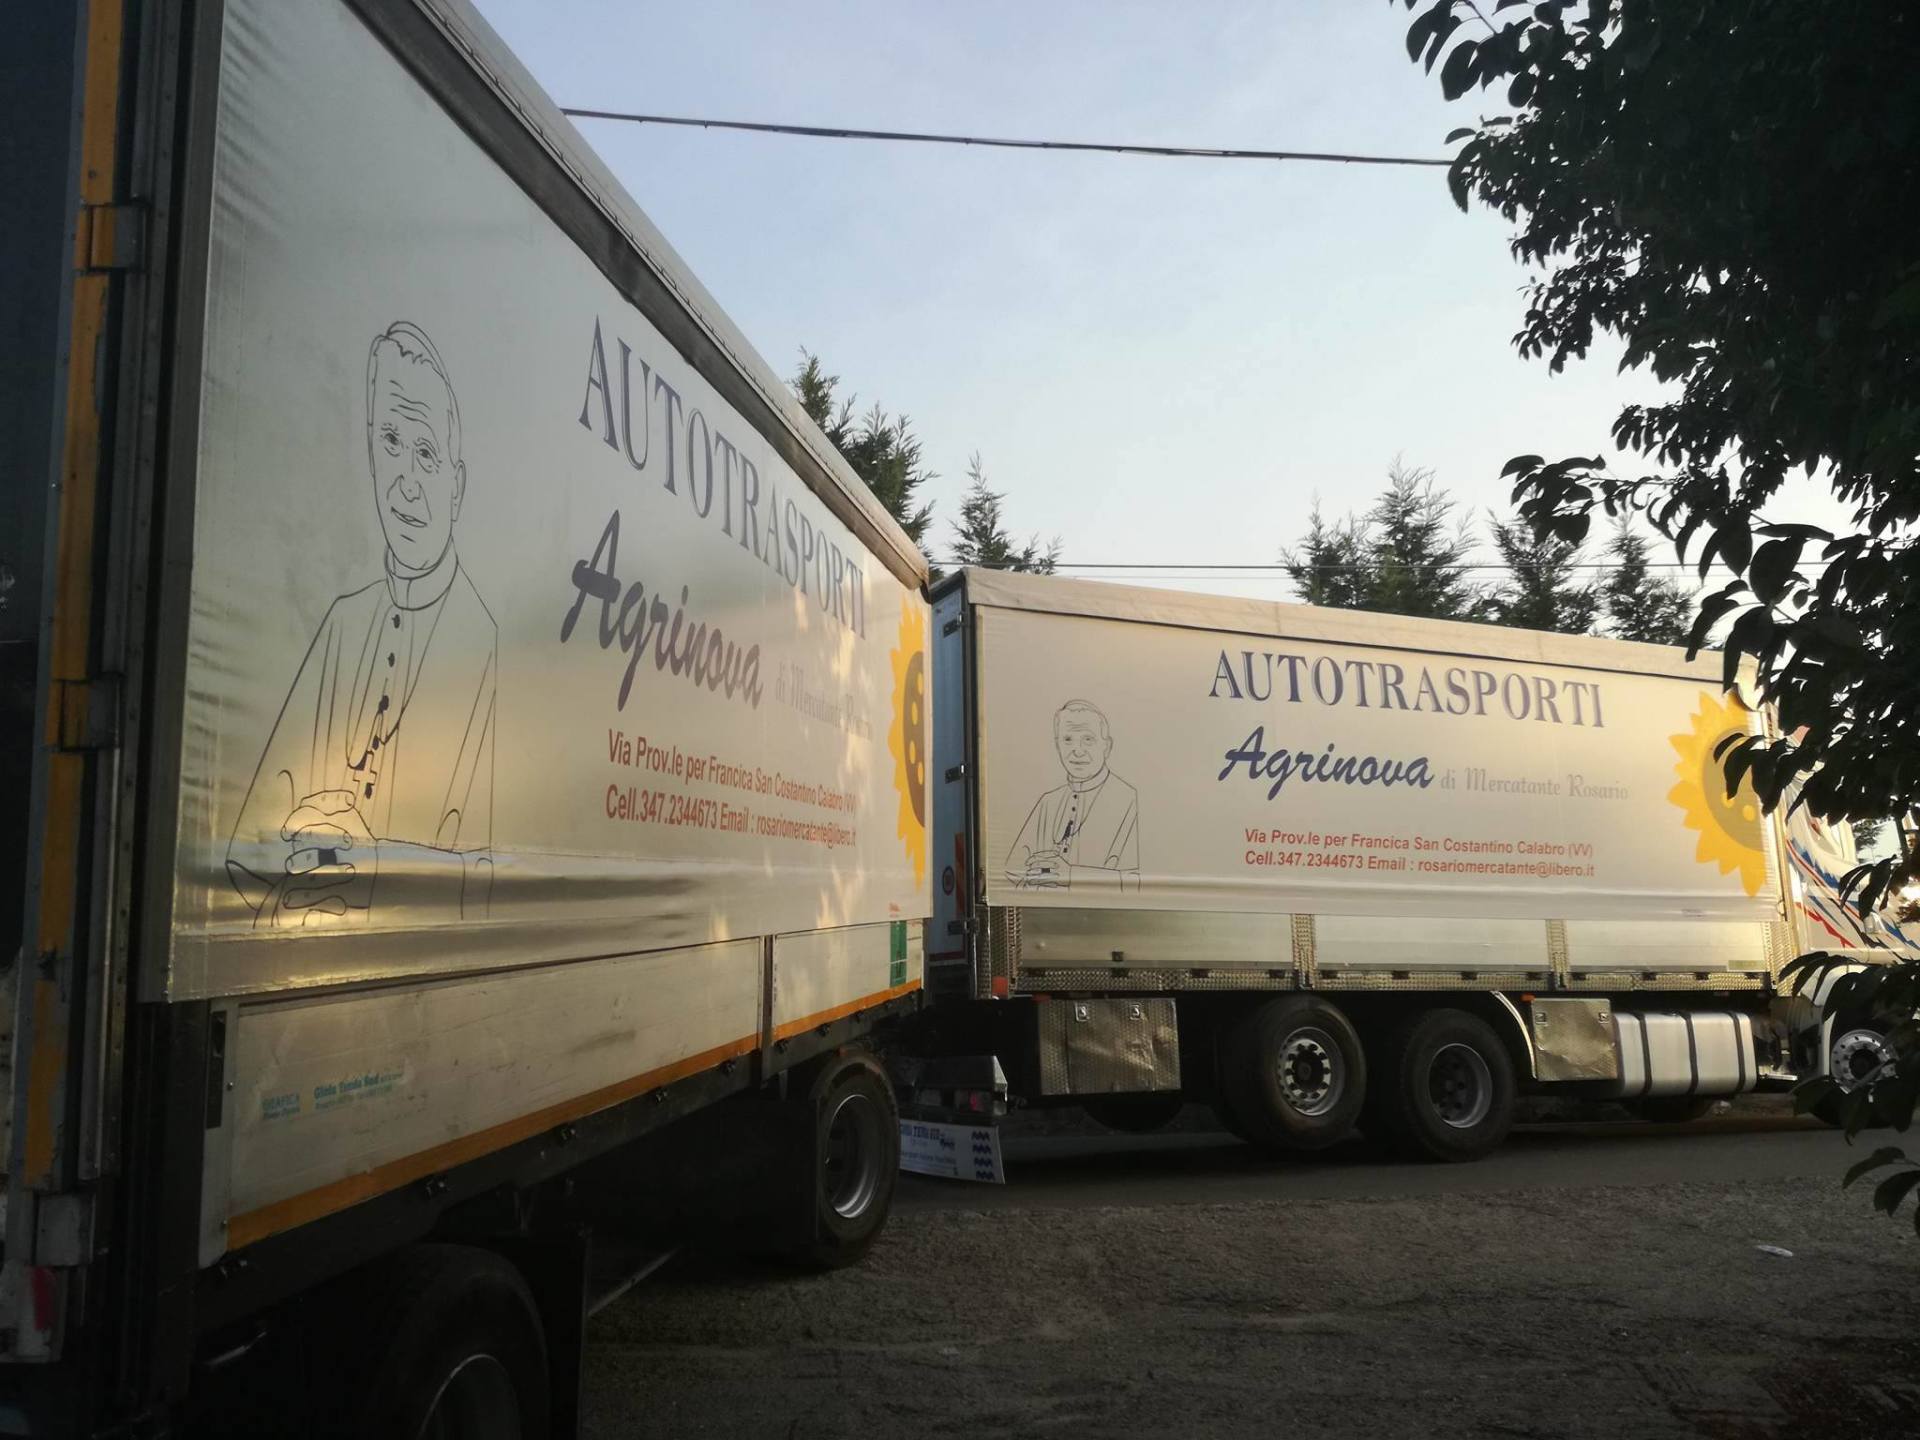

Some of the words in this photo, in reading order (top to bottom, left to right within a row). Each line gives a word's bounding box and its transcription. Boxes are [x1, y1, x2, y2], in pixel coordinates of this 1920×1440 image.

[578, 313, 866, 641] AUTOTRASPORTI
[560, 509, 764, 712] Agrinova
[1208, 649, 1606, 729] AUTOTRASPORTI
[608, 728, 632, 767] Via
[636, 736, 684, 777] Prov.le
[685, 755, 706, 785] per
[708, 755, 753, 791] Francica
[755, 767, 773, 796] San
[1217, 725, 1436, 801] Agrinova
[1440, 767, 1457, 791] di
[1464, 767, 1561, 797] Mercatante
[1567, 773, 1630, 801] Rosario
[606, 784, 718, 830] Cell.347.2344673
[719, 801, 749, 833] Email
[1244, 828, 1267, 844] Via
[1271, 829, 1321, 846] Prov.le
[1324, 833, 1347, 849] per
[1351, 833, 1410, 850] Francica
[1414, 836, 1440, 851] San
[1443, 837, 1514, 854] Costantino
[1517, 840, 1566, 856] Calabro
[1568, 842, 1594, 858] (VV)
[1244, 850, 1364, 869] Cell.347.2344673
[1367, 855, 1406, 871] Email
[1417, 859, 1596, 879] rosariomercatante@libero.it
